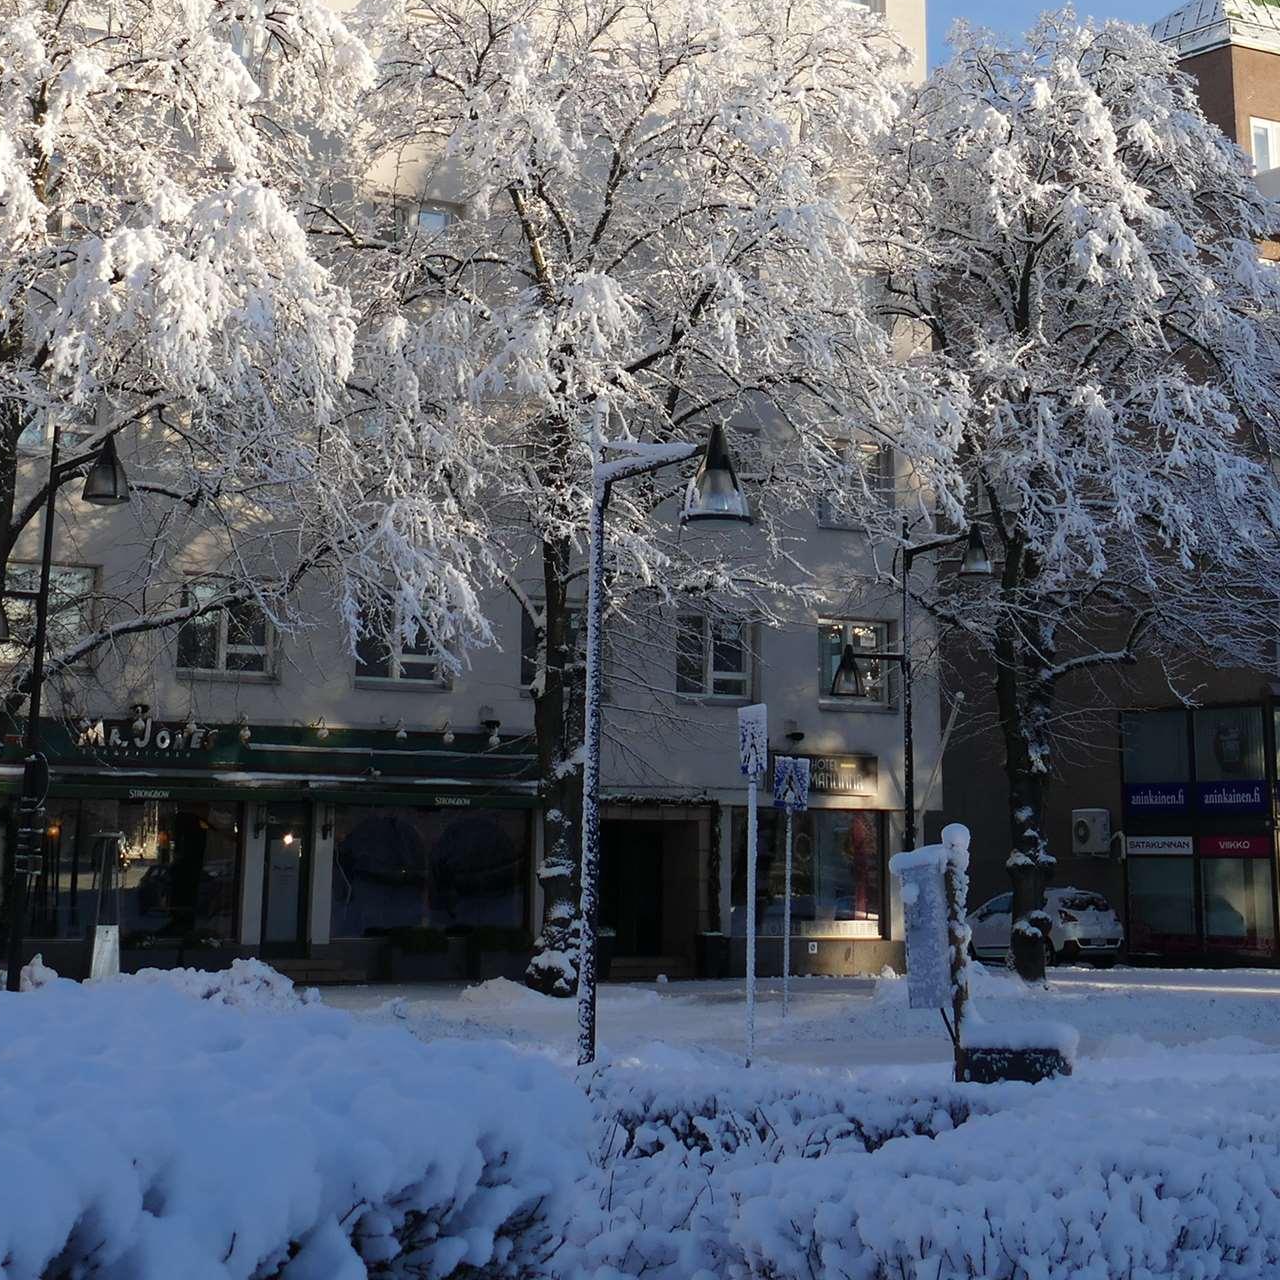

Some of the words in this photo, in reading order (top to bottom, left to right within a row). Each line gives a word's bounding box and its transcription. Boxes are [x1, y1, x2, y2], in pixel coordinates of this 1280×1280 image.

[811, 758, 838, 770] HOTEL
[1130, 788, 1185, 805] aninkainen.fi
[1203, 786, 1261, 805] aninkainen.fi
[1128, 840, 1191, 850] SATAKUNNAN
[1218, 840, 1251, 850] VIIKKO
